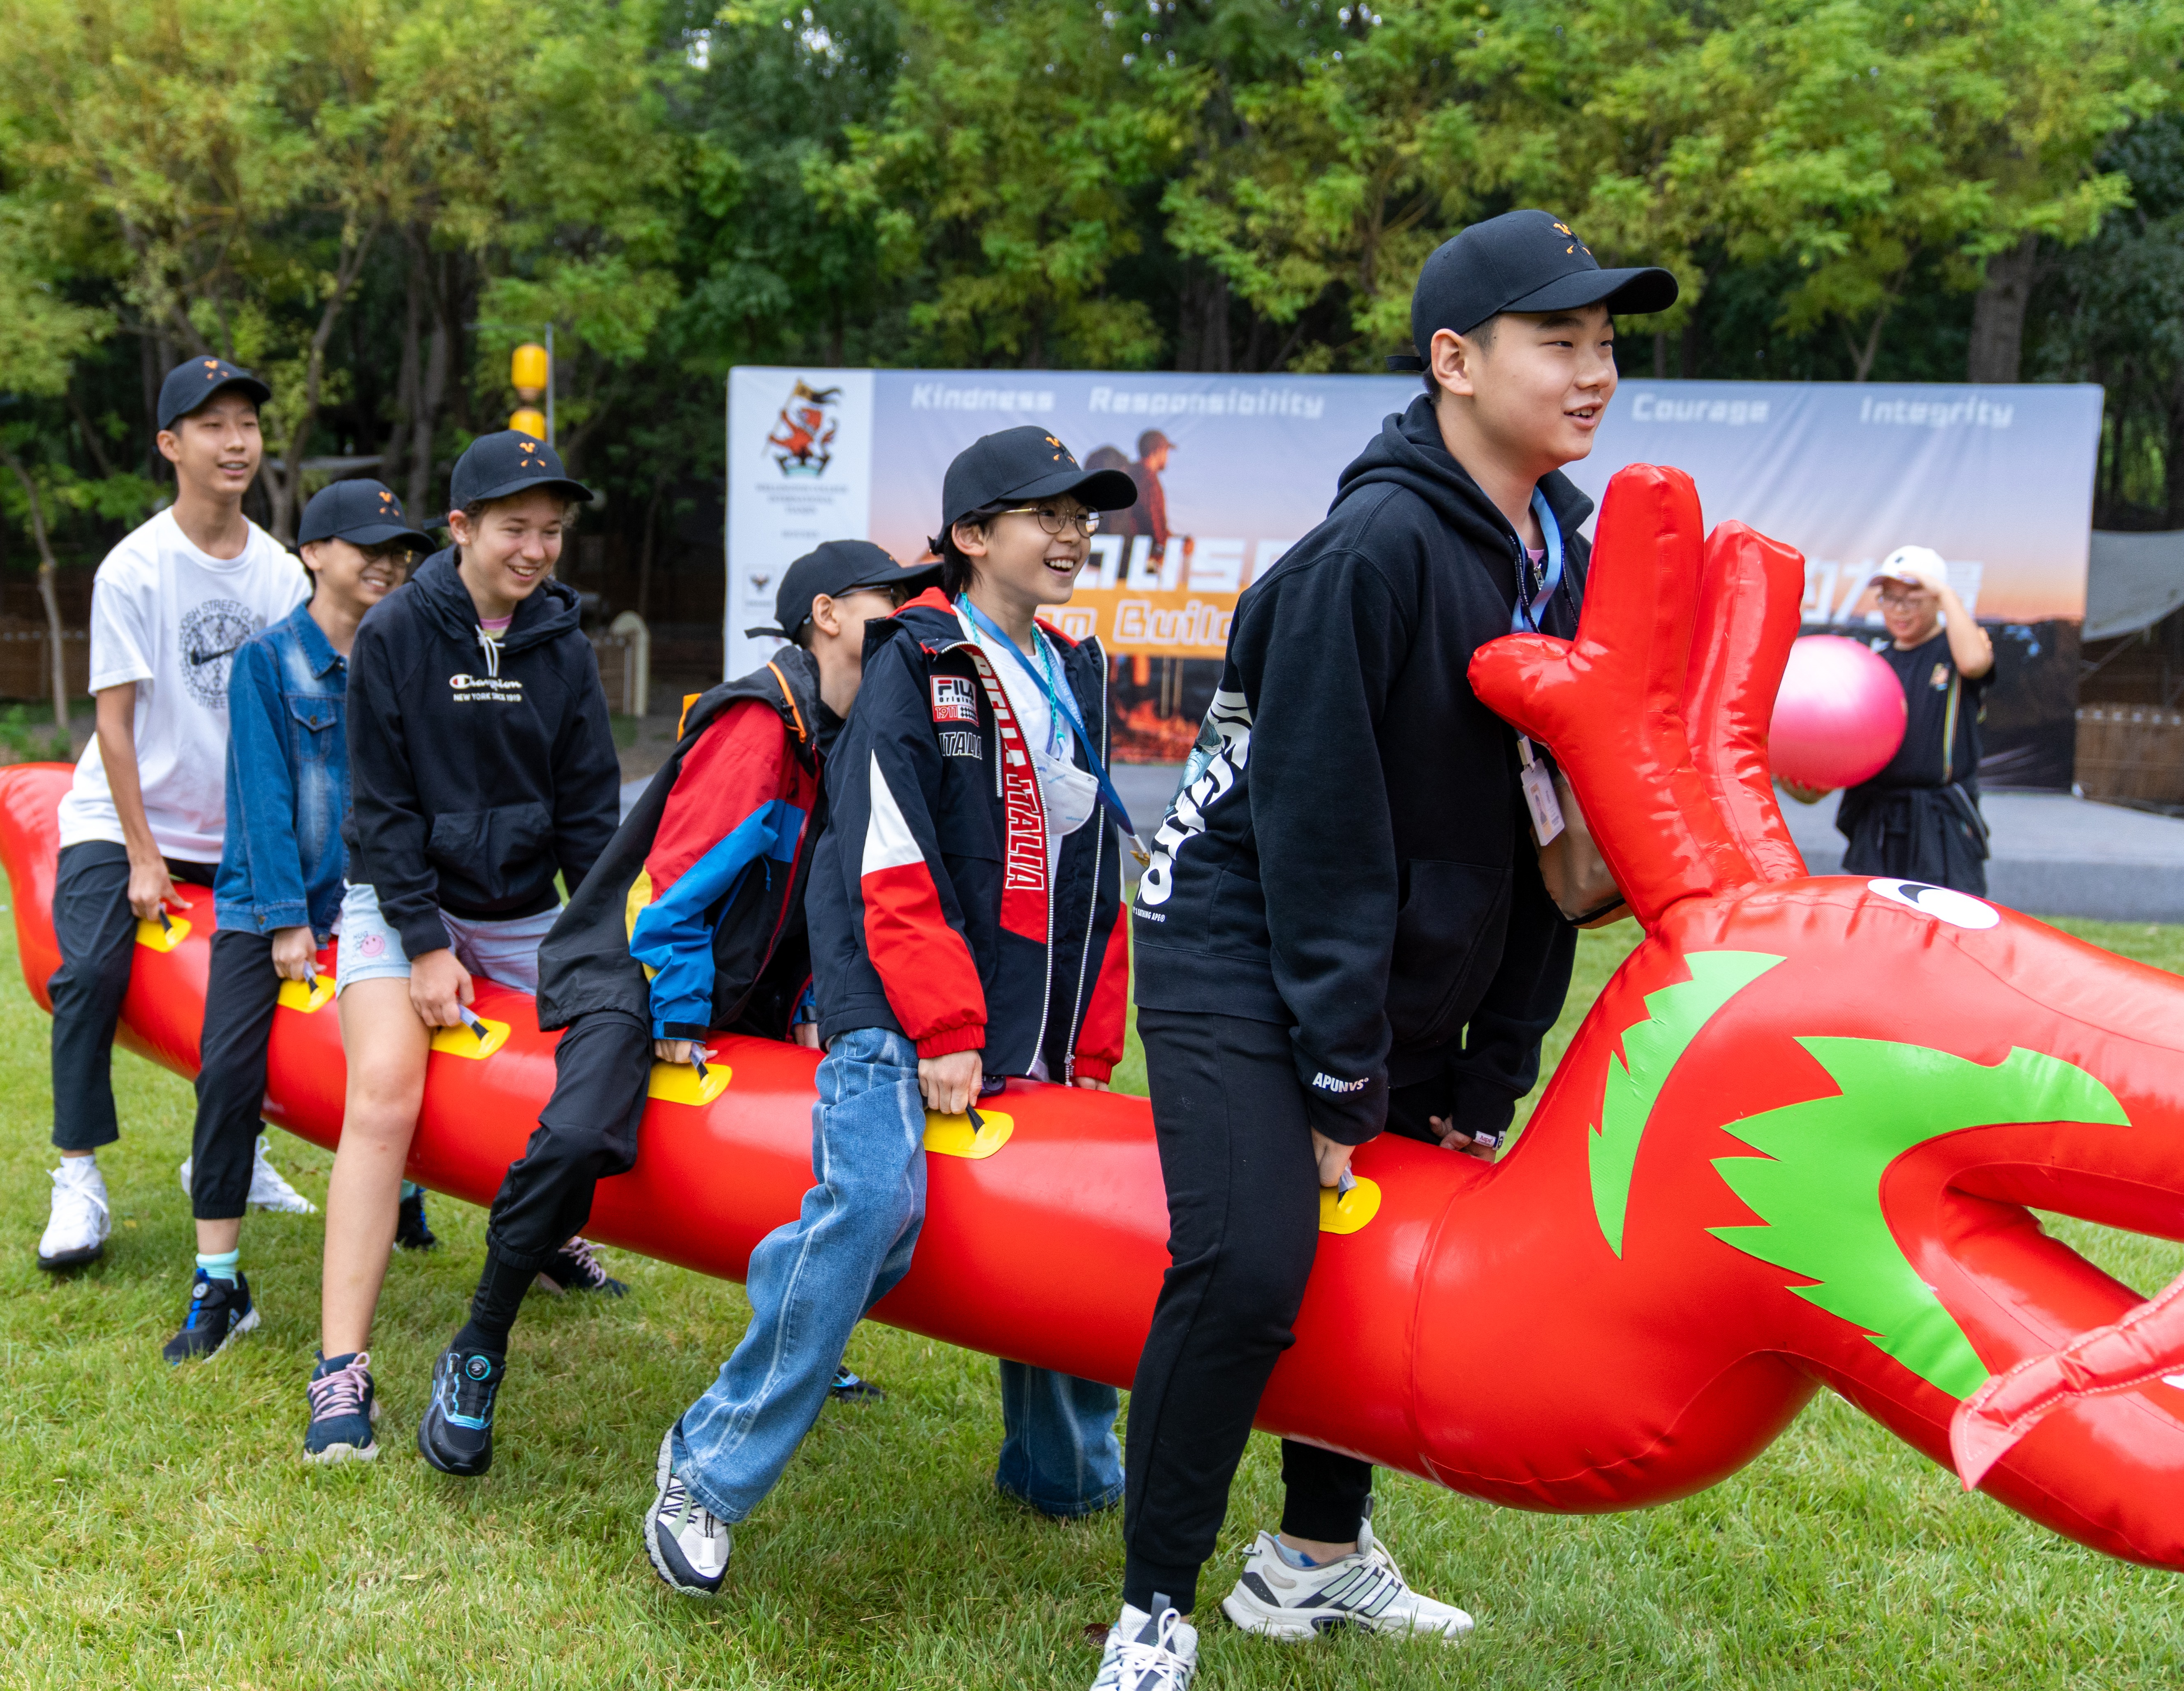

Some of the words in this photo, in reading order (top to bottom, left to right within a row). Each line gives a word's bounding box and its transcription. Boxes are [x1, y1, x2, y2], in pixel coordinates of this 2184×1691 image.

[1631, 392, 1770, 426] Courage
[1860, 394, 2015, 429] Integrity
[937, 679, 974, 701] FILA
[935, 706, 958, 719] 1911
[939, 731, 983, 760] ITALIA
[1005, 773, 1044, 891] ITALIA
